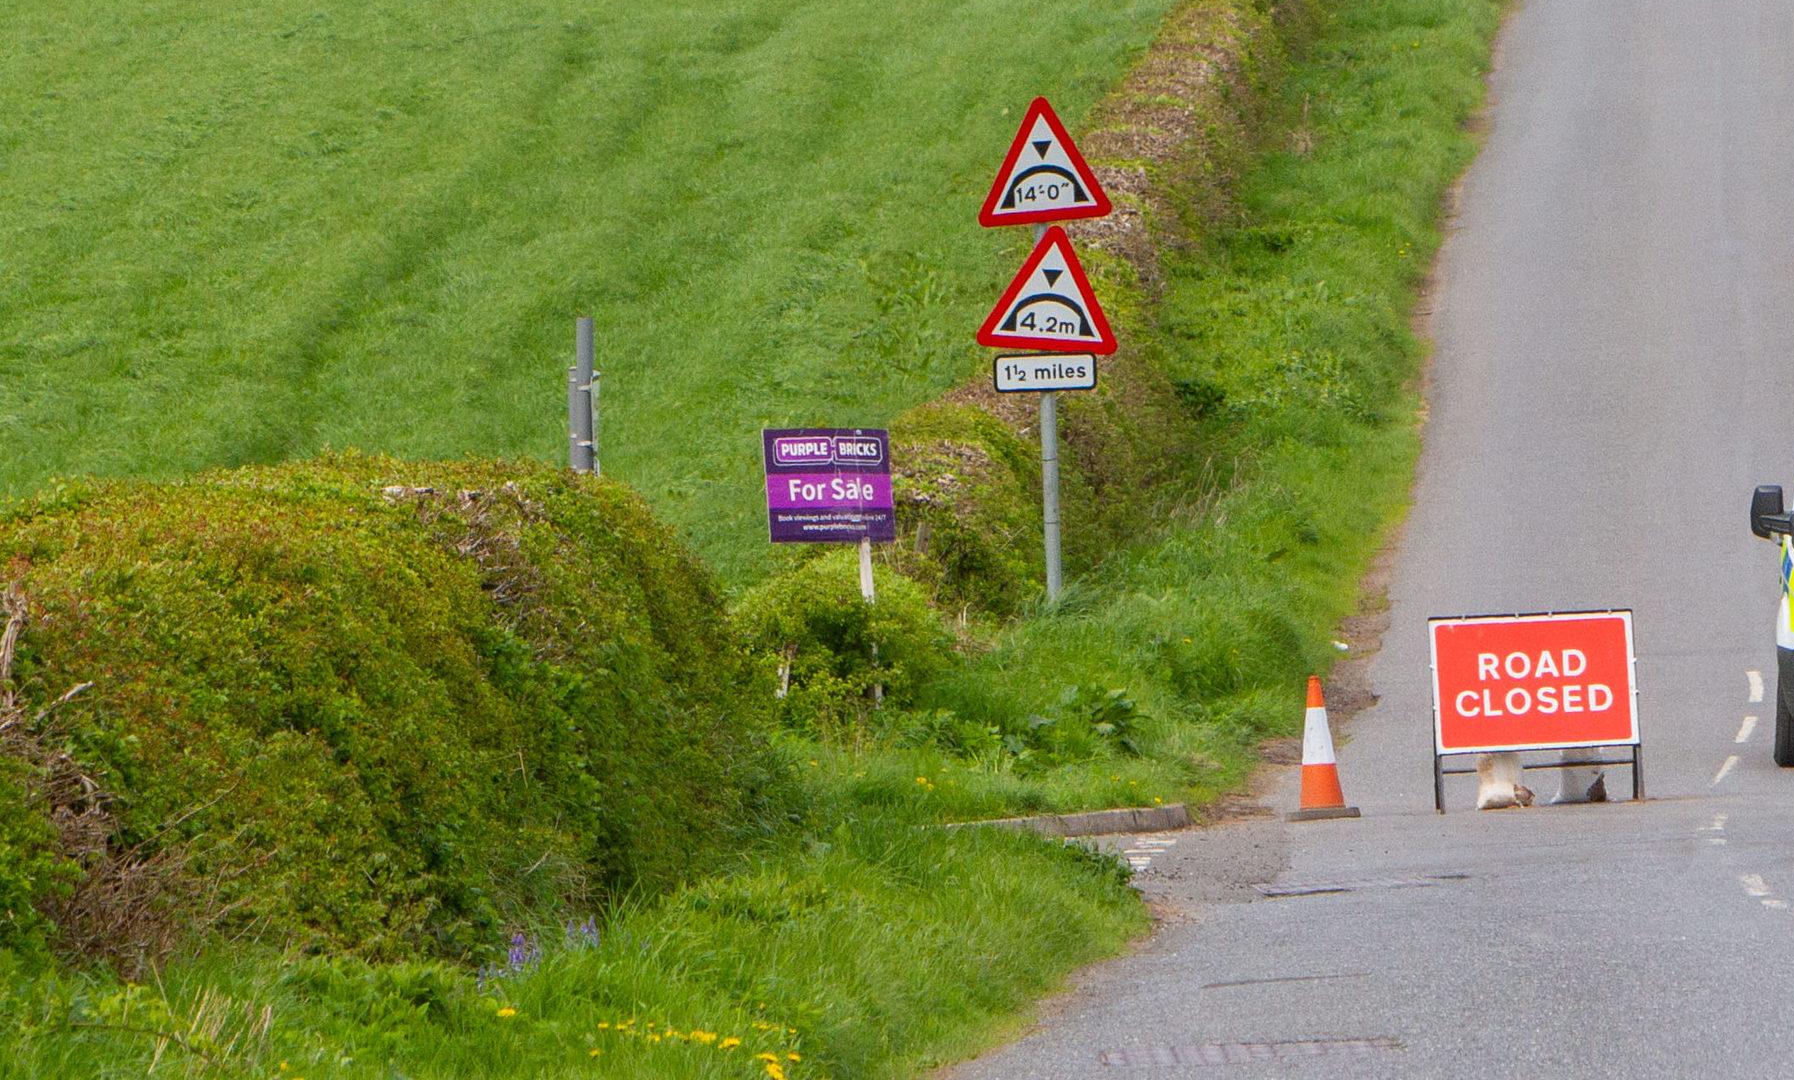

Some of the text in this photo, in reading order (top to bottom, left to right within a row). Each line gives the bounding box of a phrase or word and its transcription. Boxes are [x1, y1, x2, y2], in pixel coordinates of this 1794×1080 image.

[1020, 312, 1075, 335] 4.2m
[1035, 363, 1086, 380] miles
[781, 443, 877, 456] PURPLE BRICKS
[789, 478, 874, 502] For Sale
[1478, 649, 1587, 681] ROAD
[1455, 684, 1613, 717] CLOSED
